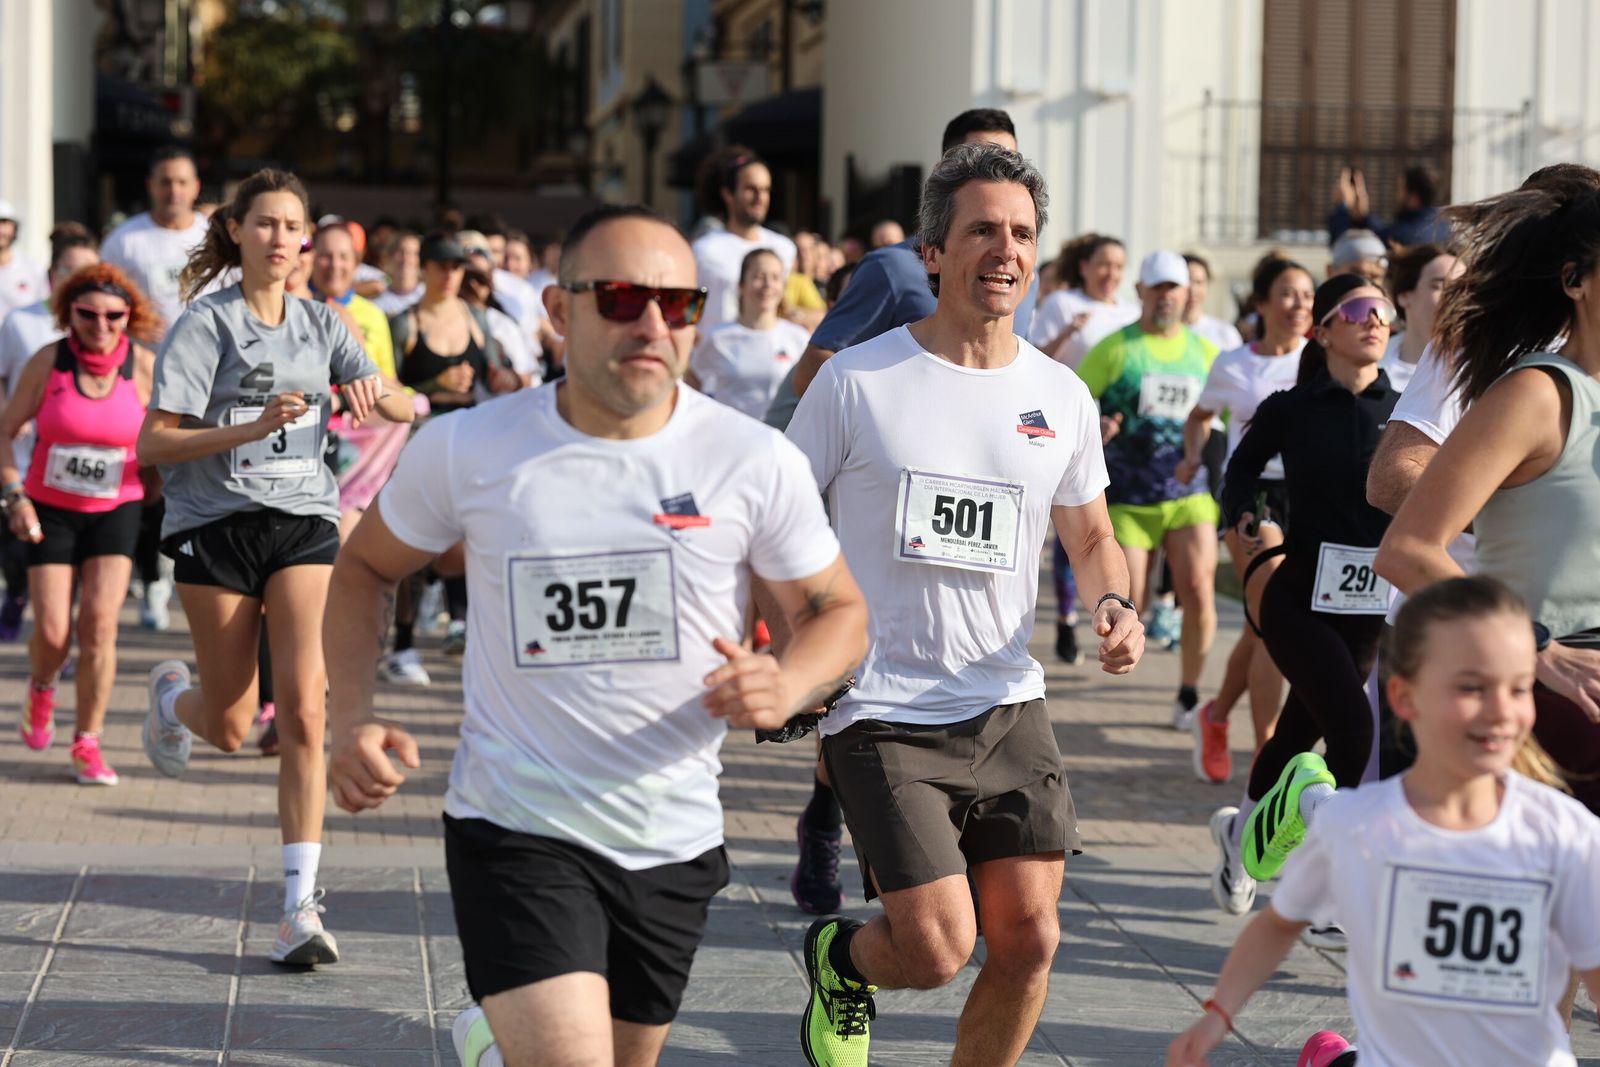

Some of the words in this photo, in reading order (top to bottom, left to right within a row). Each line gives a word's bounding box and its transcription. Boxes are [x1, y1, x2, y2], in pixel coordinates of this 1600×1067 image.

[931, 494, 994, 541] 501
[544, 578, 636, 632] 357
[1424, 899, 1523, 965] 503
